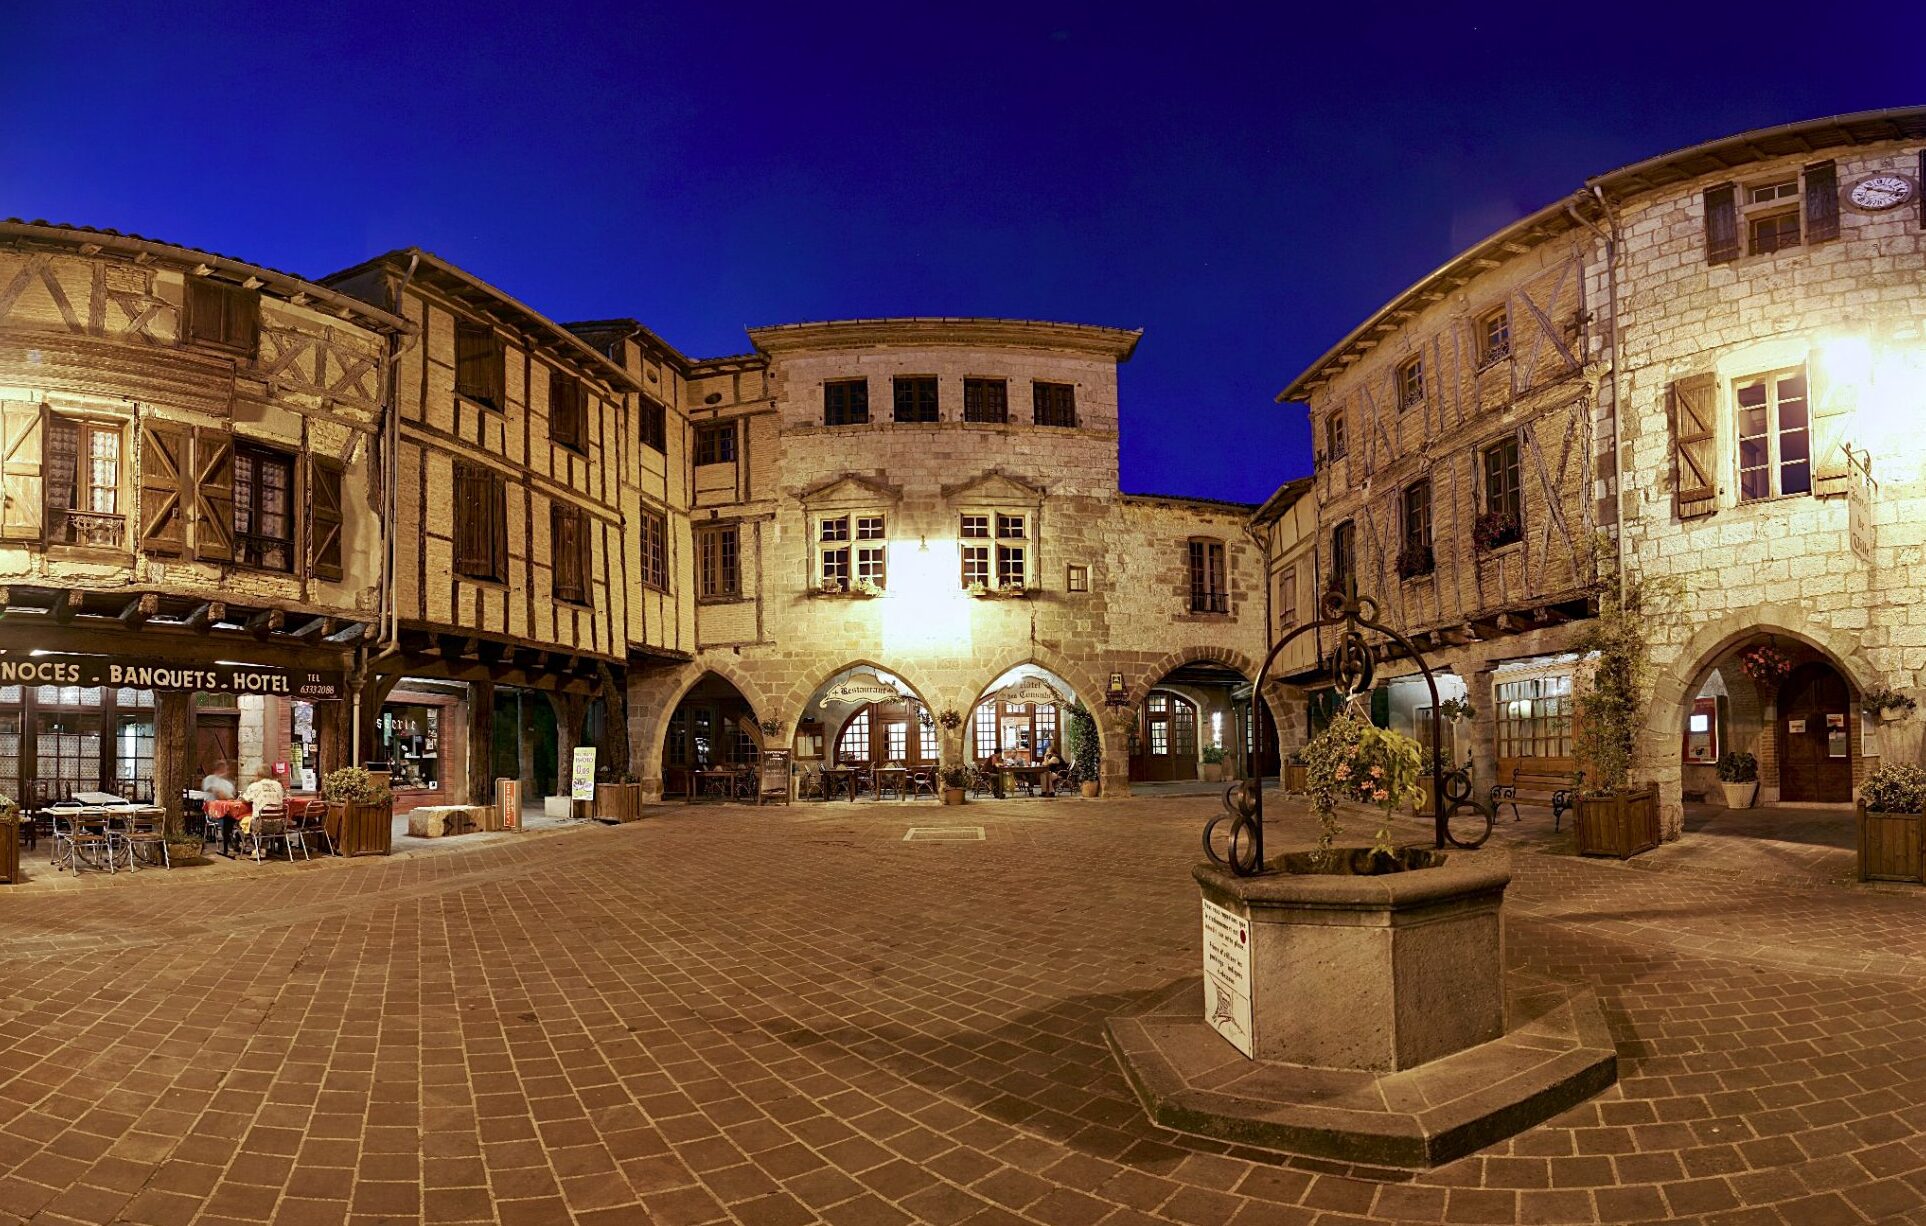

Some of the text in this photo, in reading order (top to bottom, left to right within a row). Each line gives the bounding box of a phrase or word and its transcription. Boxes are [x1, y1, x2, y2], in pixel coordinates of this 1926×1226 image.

[1, 661, 80, 682] NOCES
[109, 664, 216, 689] BANQUETS
[233, 672, 290, 692] HOTEL
[307, 673, 321, 682] TEL
[840, 686, 887, 695] Restaurant
